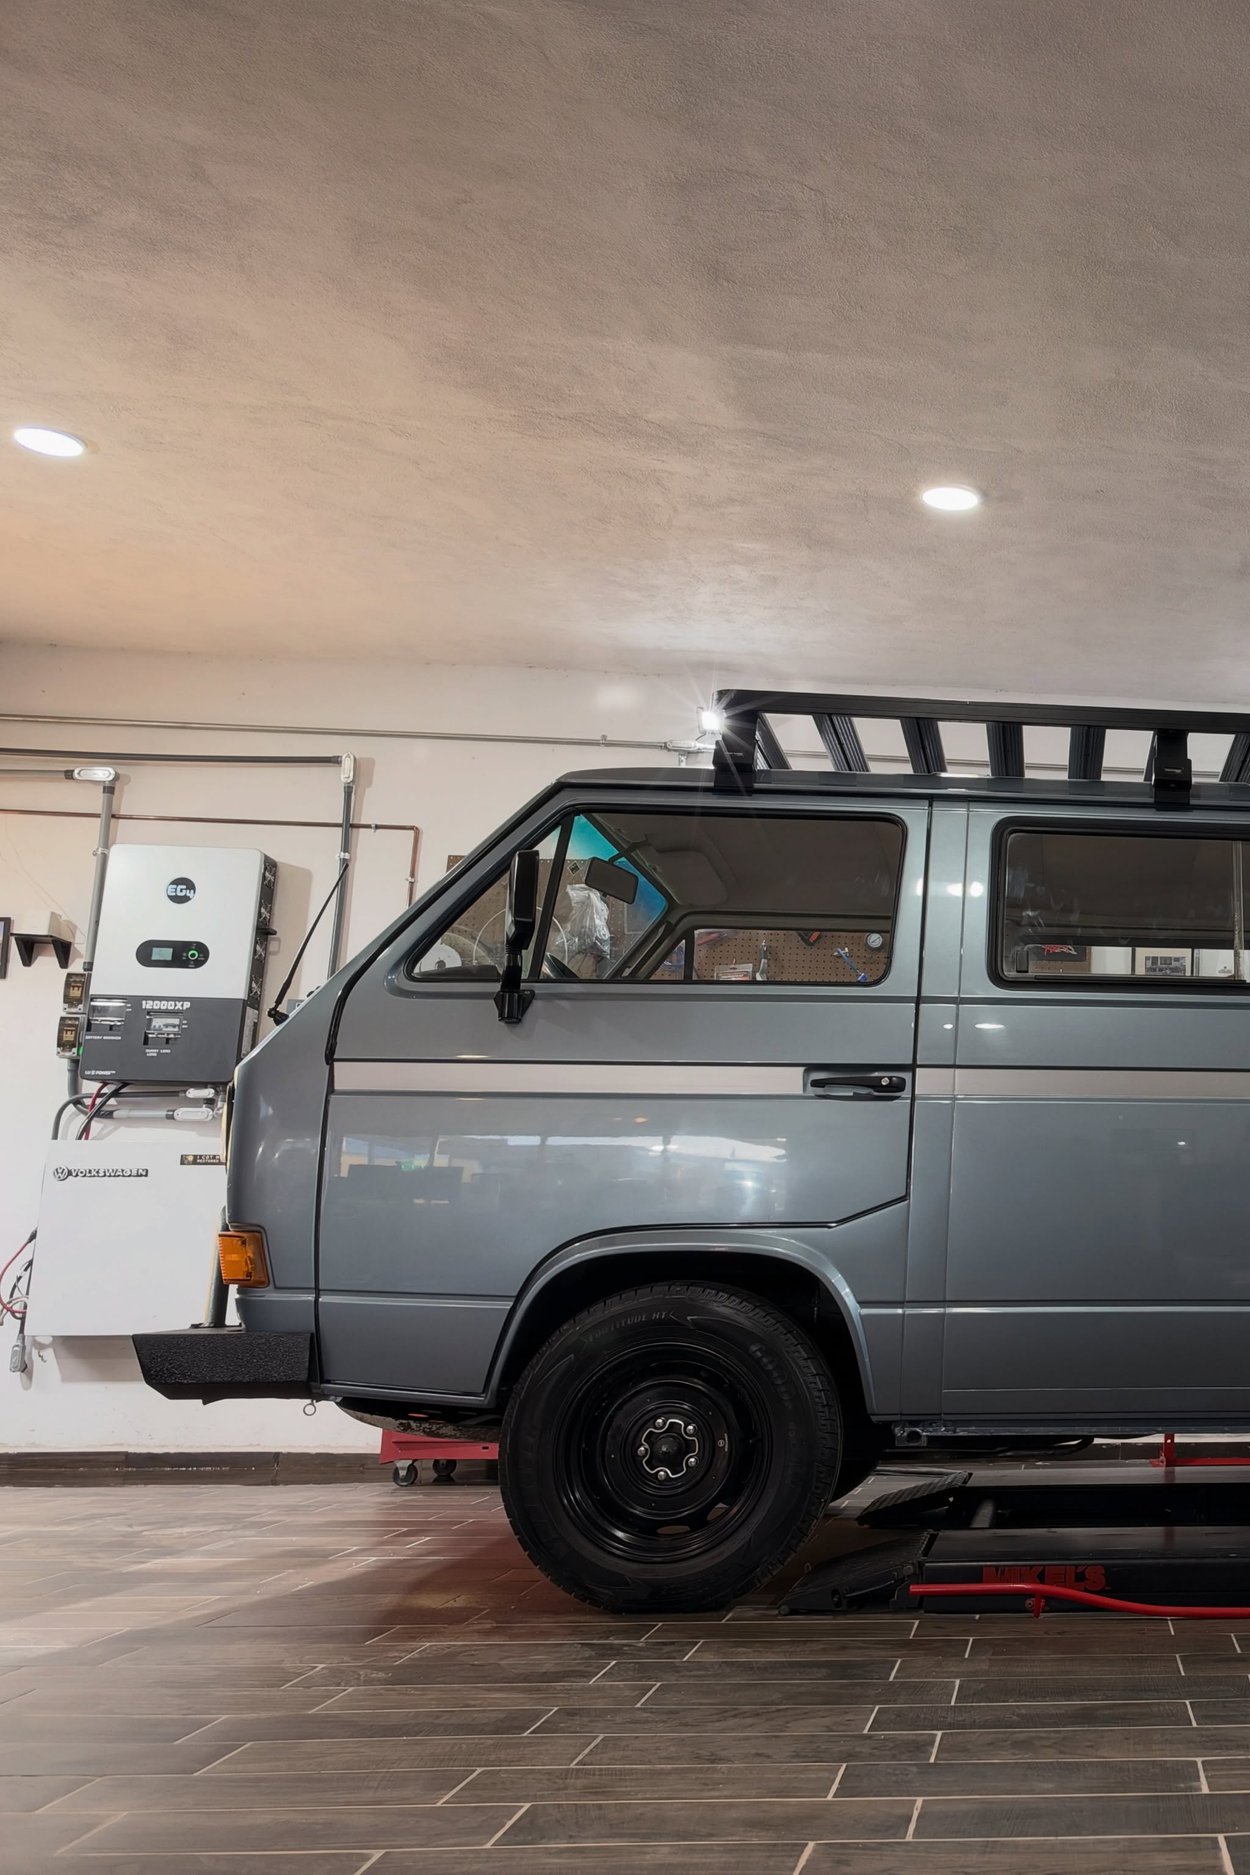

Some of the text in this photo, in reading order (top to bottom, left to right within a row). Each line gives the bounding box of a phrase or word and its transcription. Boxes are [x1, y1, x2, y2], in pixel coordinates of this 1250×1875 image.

[167, 884, 195, 899] EG4
[142, 1000, 191, 1010] 12000XP
[70, 1168, 148, 1178] VOLKSWAGEN
